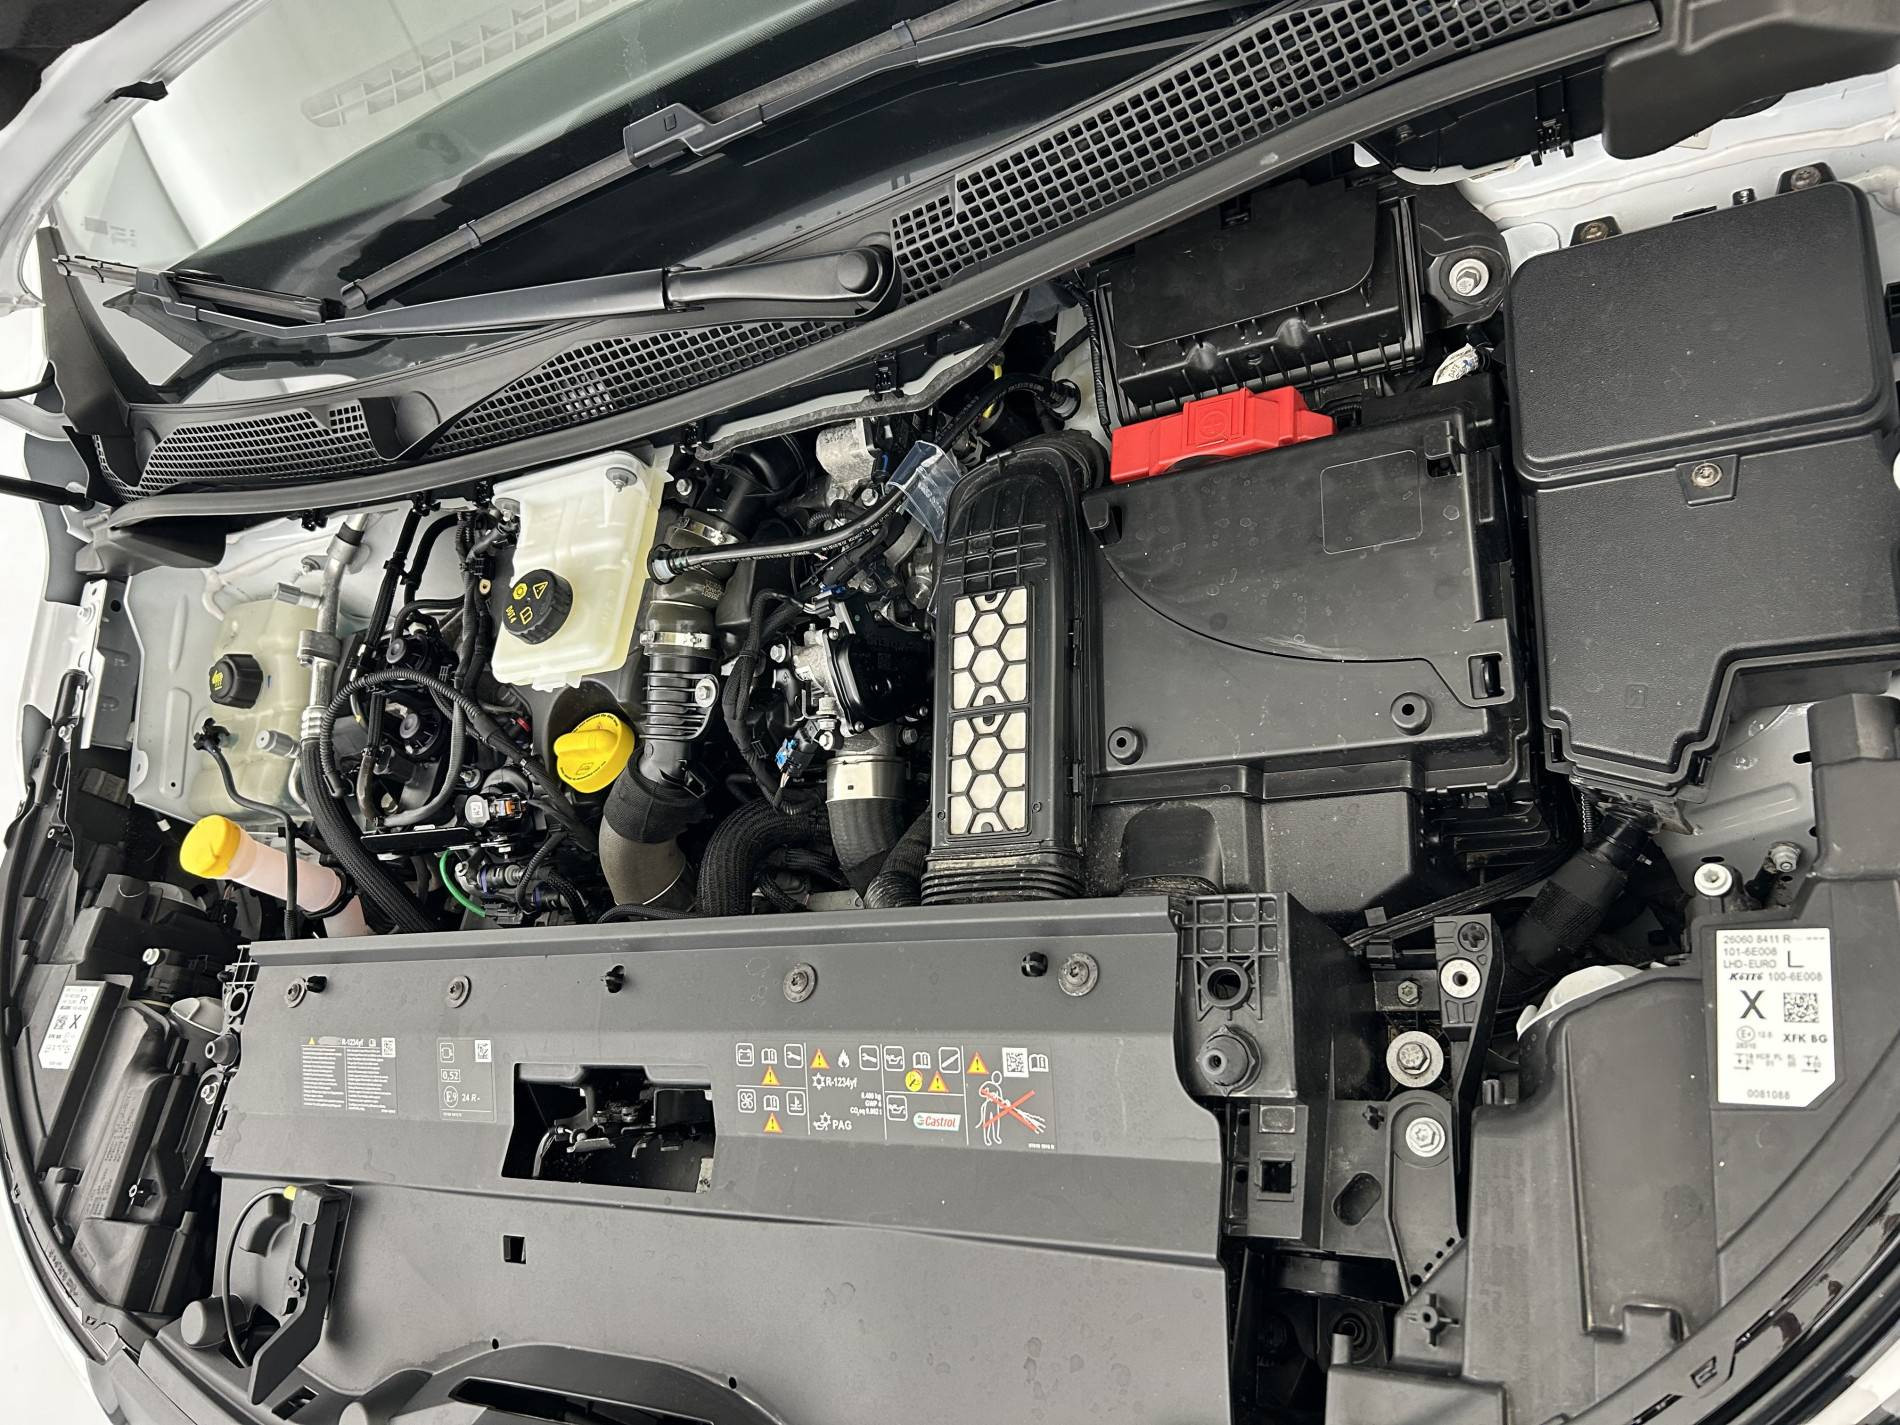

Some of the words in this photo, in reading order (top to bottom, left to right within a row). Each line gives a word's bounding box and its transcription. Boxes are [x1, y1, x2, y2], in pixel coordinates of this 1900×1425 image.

[1783, 935, 1791, 944] R
[1787, 950, 1805, 968] L
[1739, 990, 1766, 1019] X
[69, 1014, 82, 1029] X
[442, 1070, 459, 1081] 0,52
[825, 1076, 857, 1089] R-1234yf
[832, 1119, 852, 1130] PAG
[925, 1115, 957, 1128] Castrol
